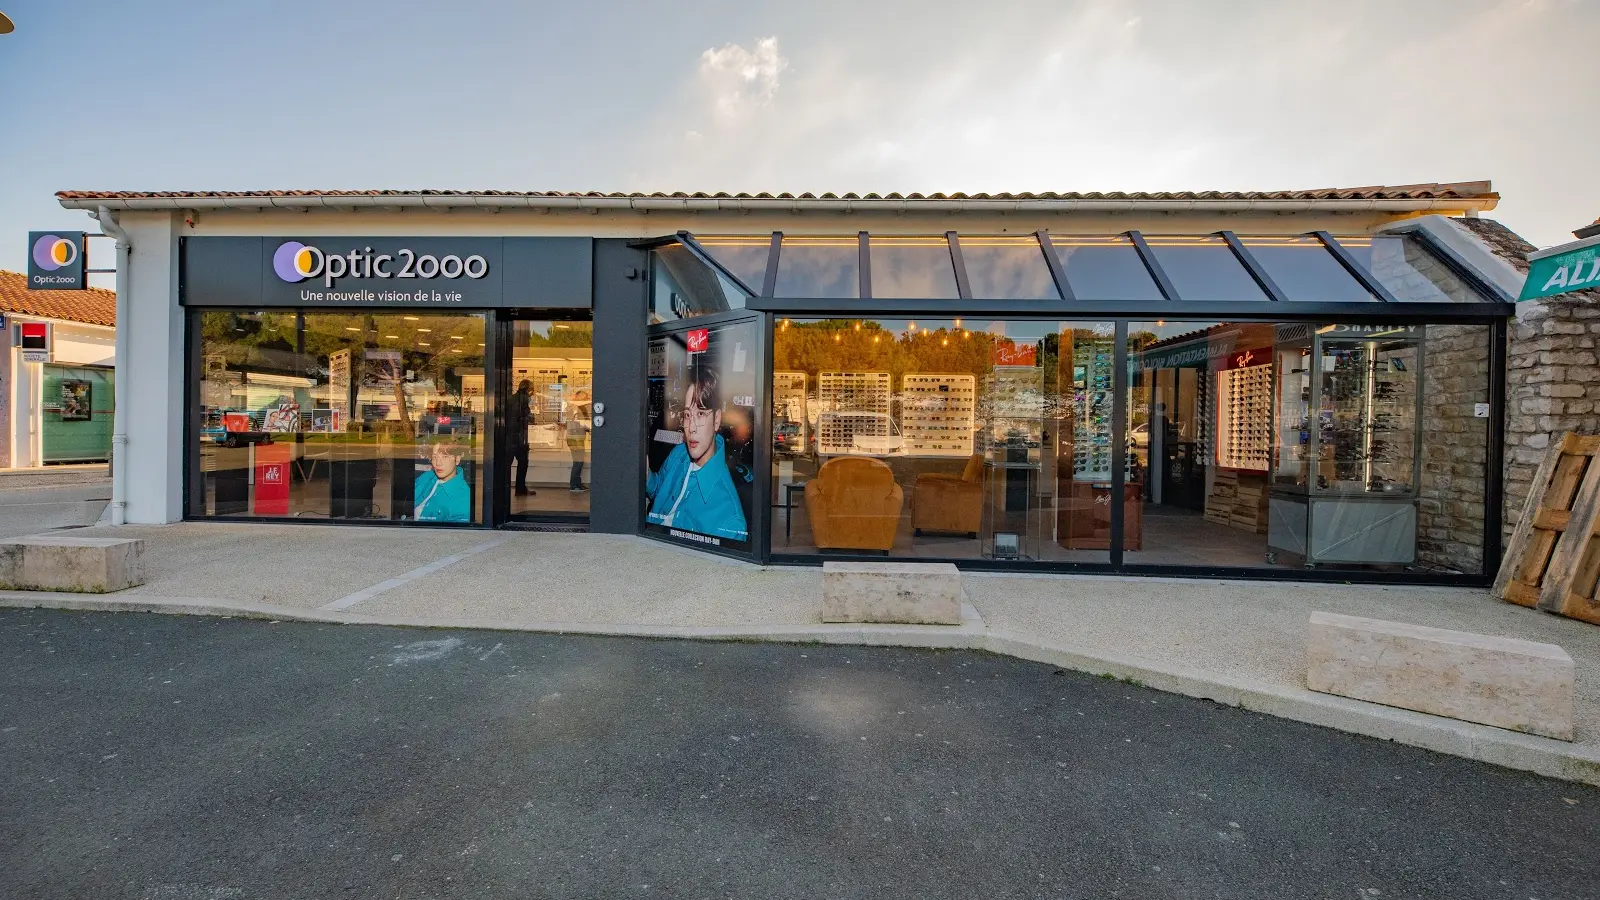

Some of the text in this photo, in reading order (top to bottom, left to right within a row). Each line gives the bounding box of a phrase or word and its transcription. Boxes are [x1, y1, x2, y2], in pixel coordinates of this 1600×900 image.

[293, 246, 488, 288] Optic 2000
[1541, 256, 1600, 291] ALI
[33, 275, 76, 286] Optic 2000
[301, 290, 462, 302] Une nouvelle vision de la vie
[265, 472, 280, 480] REY
